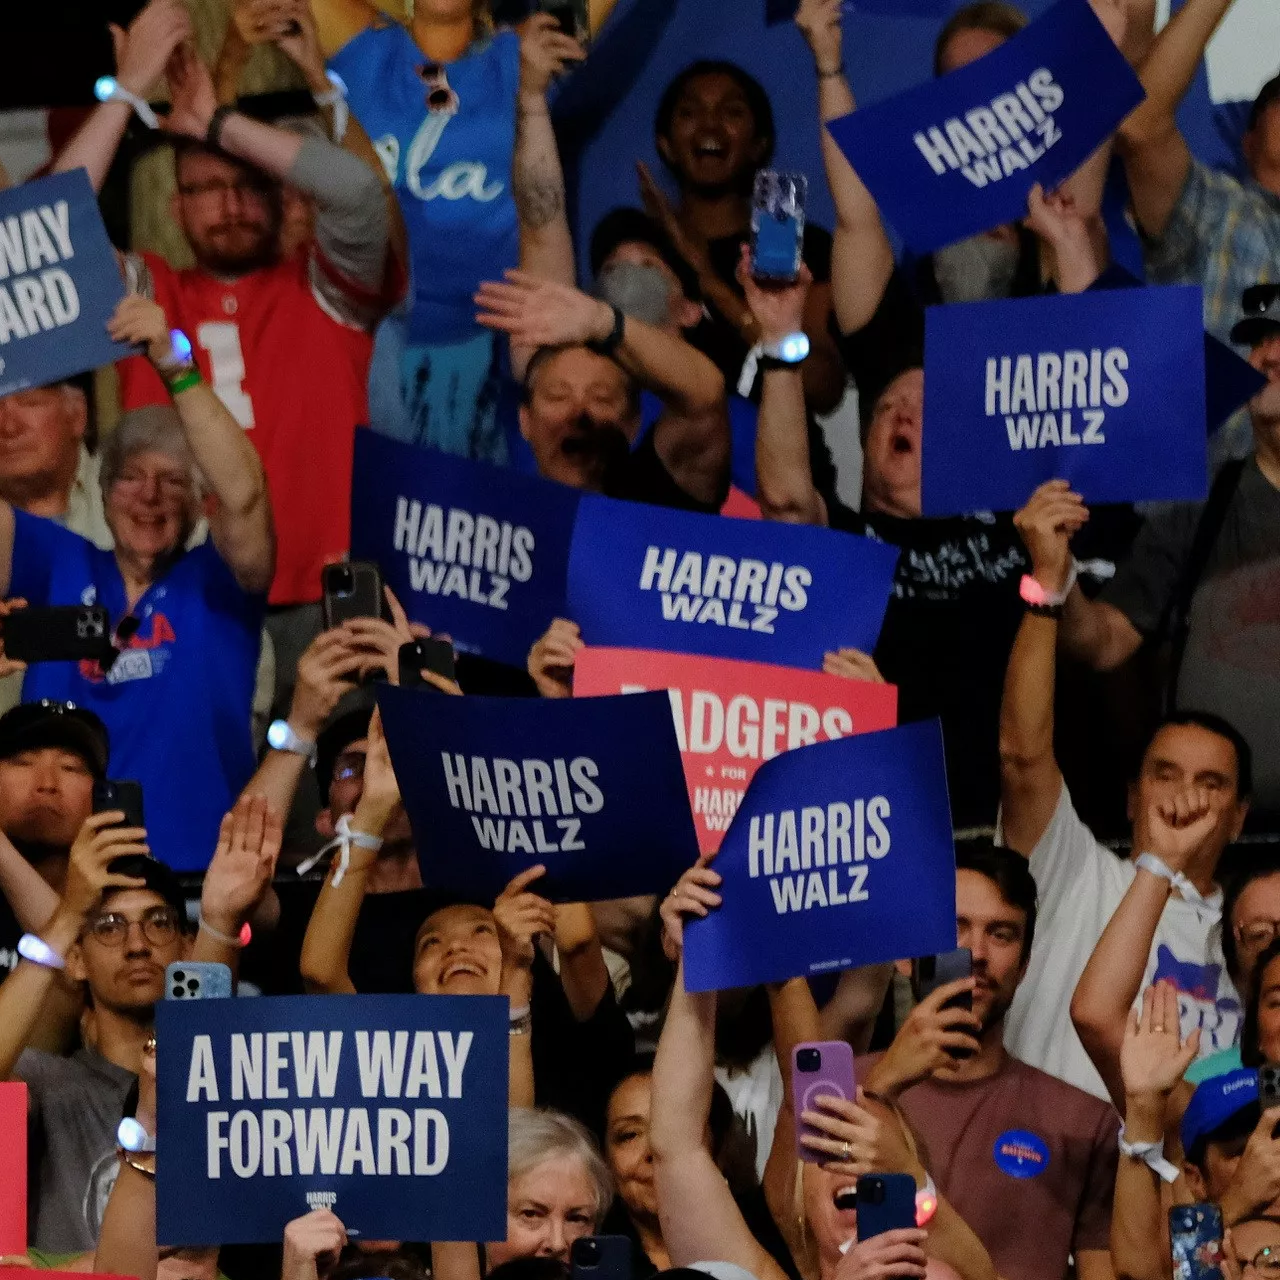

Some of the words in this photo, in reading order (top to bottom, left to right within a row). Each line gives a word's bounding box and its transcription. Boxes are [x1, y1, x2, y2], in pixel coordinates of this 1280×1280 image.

[912, 67, 1065, 175] HARRIS
[960, 116, 1062, 189] WALZ
[984, 347, 1130, 416] HARRIS
[1006, 408, 1105, 451] WALZ
[393, 496, 534, 583] HARRIS
[408, 556, 510, 610] WALZ
[640, 546, 812, 612] HARRIS
[661, 593, 778, 634] WALZ
[441, 751, 604, 817] HARRIS
[471, 815, 586, 854] WALZ
[748, 796, 891, 878] HARRIS
[770, 865, 868, 914] WALZ
[186, 1034, 220, 1102] A
[230, 1031, 344, 1100] NEW
[355, 1031, 474, 1098] WAY
[207, 1108, 450, 1179] FORWARD
[306, 1191, 337, 1204] HARRIS
